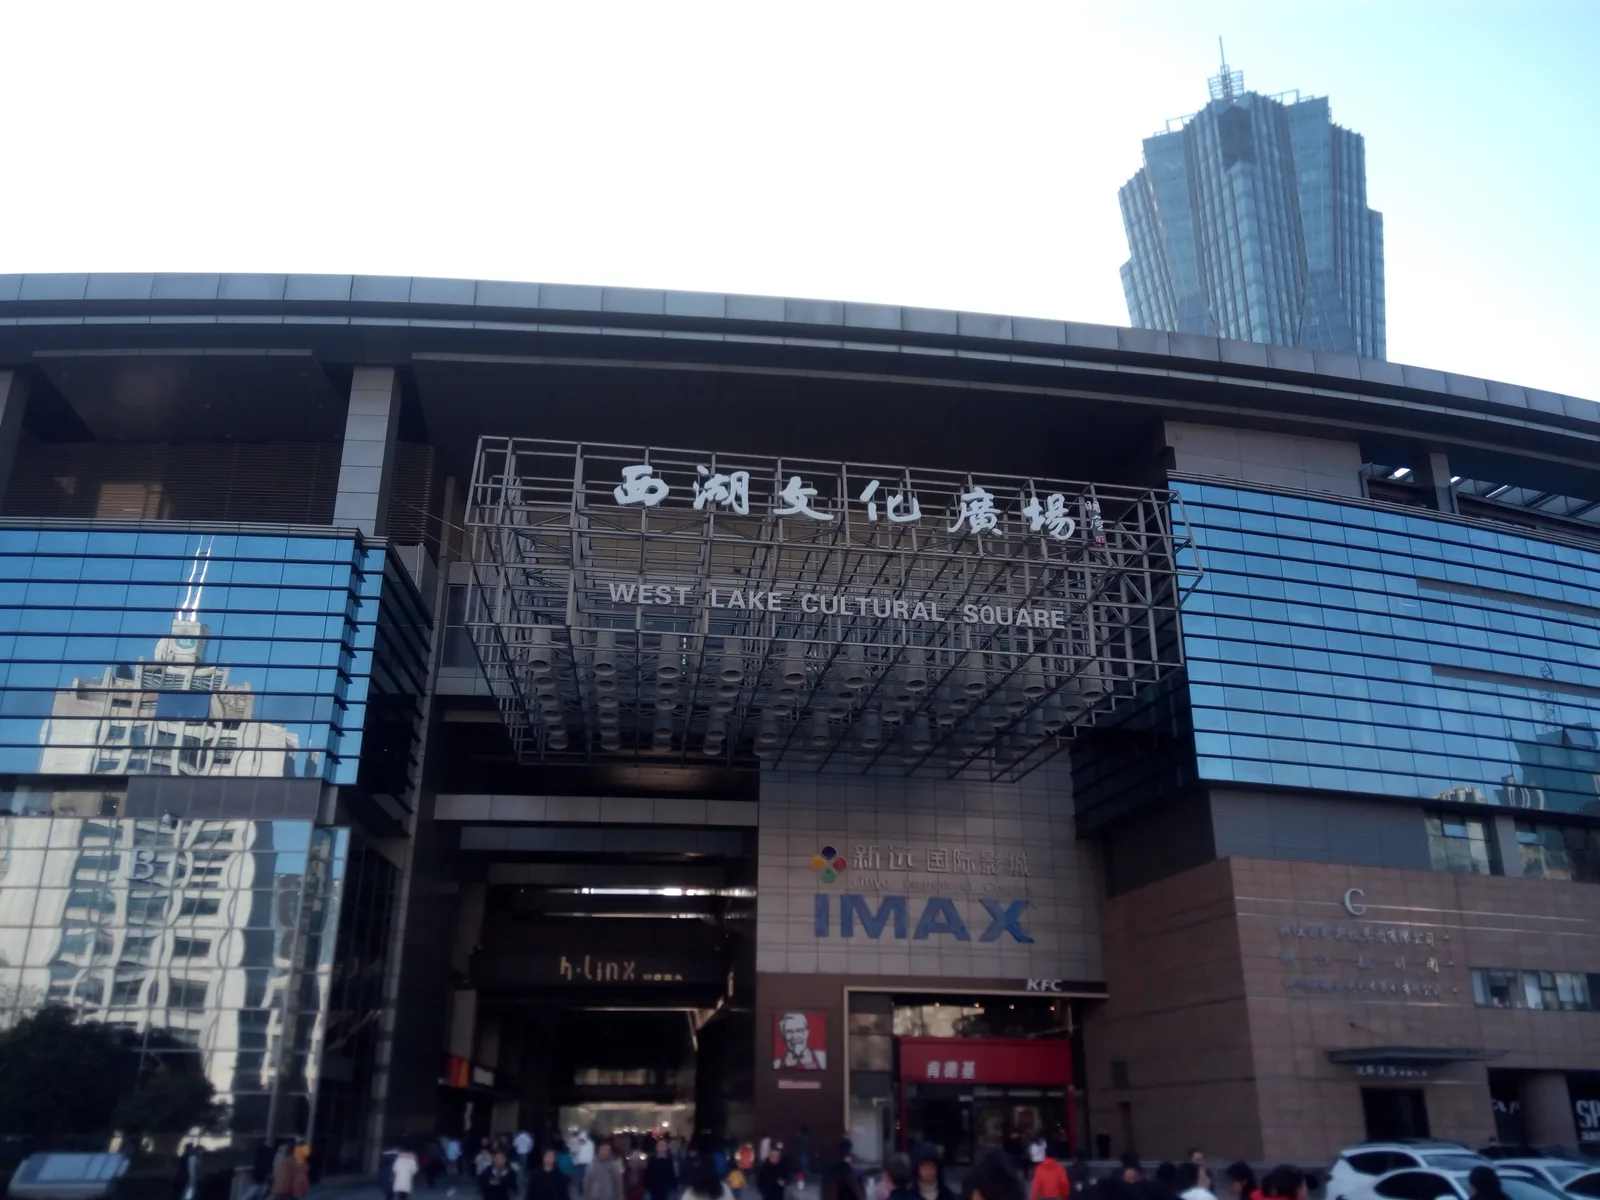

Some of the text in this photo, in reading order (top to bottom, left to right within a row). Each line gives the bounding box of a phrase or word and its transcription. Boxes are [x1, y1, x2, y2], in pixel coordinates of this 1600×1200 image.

[613, 464, 1076, 540] 西湖文化廣場
[608, 582, 1066, 629] WEST LAKE CULTURAL SQUARE
[128, 848, 158, 880] B
[852, 844, 1031, 877] 新远国际影城
[1343, 887, 1367, 916] C
[814, 893, 1035, 943] IMAX
[1026, 978, 1063, 992] KFC
[927, 1059, 977, 1080] 肯德基
